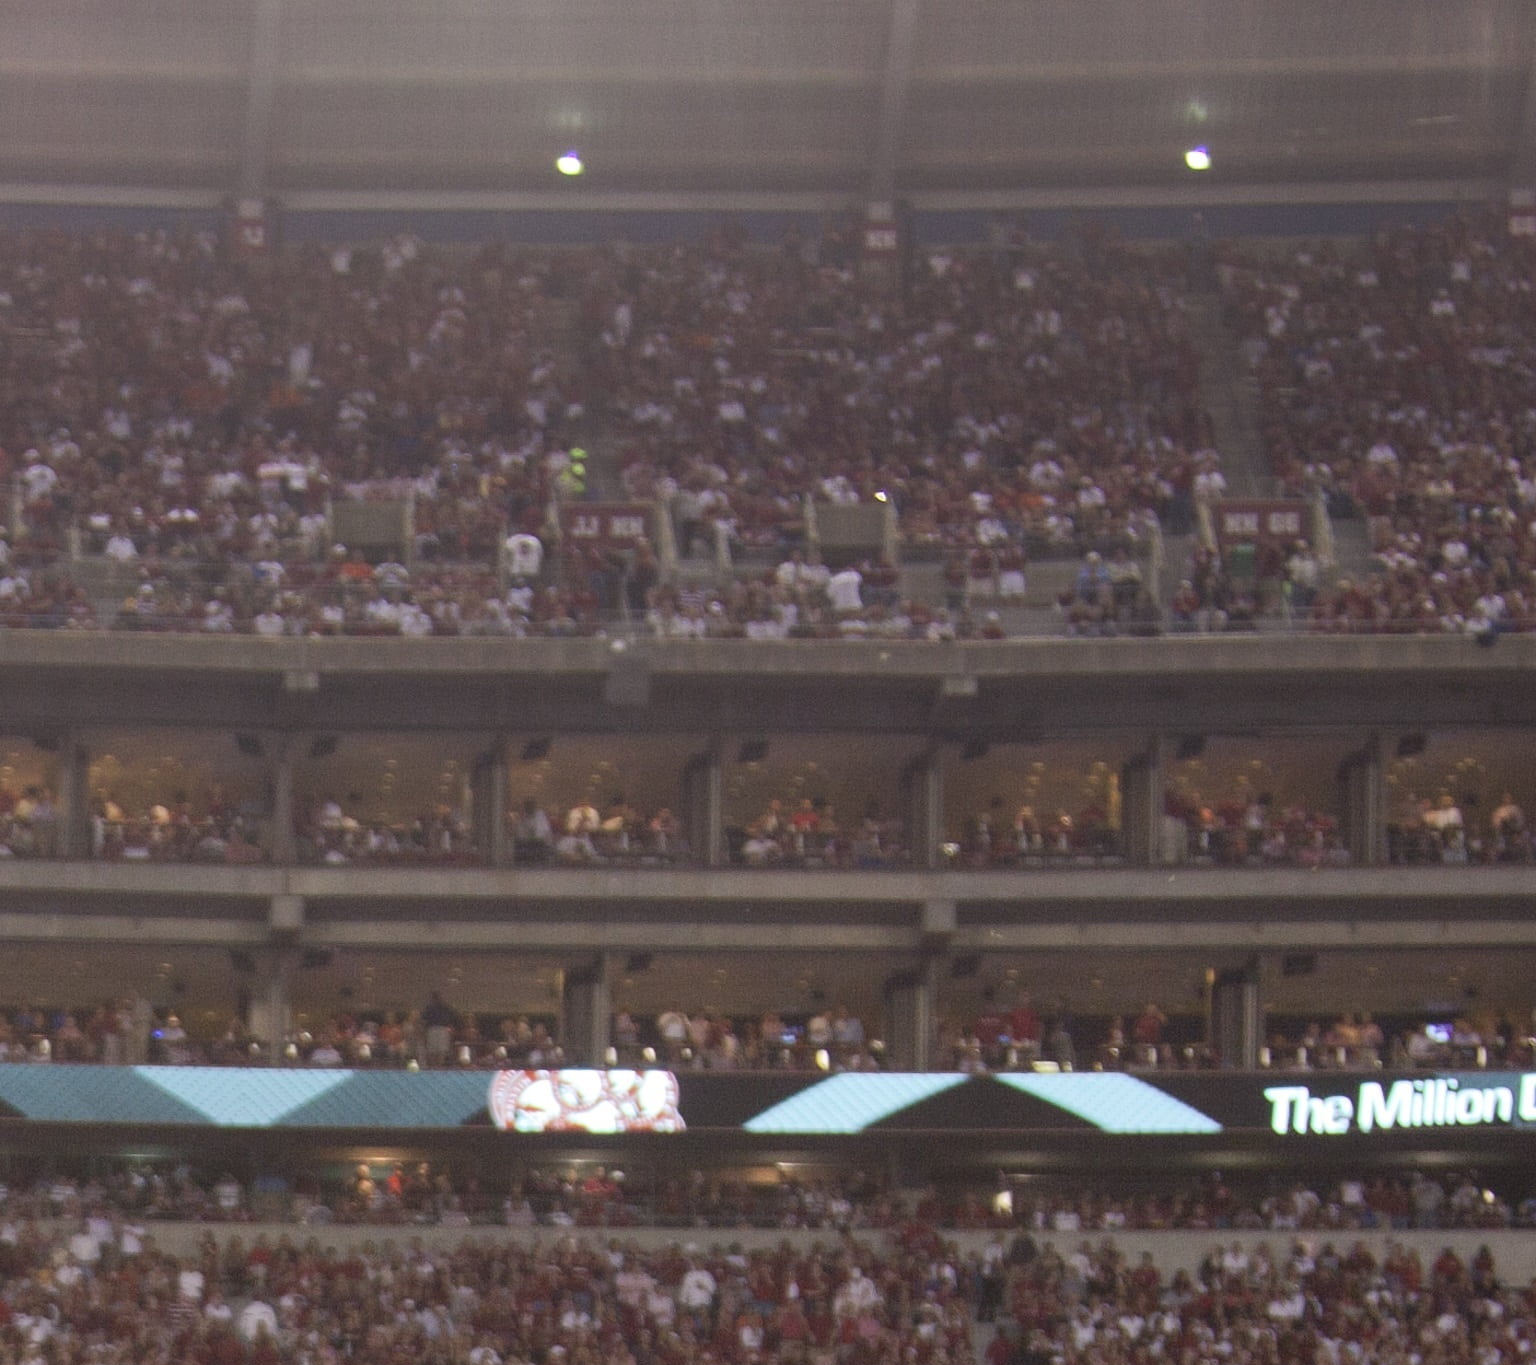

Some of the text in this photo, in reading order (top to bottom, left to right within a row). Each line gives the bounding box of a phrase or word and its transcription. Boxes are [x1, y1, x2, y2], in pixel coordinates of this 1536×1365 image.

[572, 515, 600, 538] JJ
[1264, 1086, 1353, 1135] The
[1358, 1077, 1513, 1133] Million
